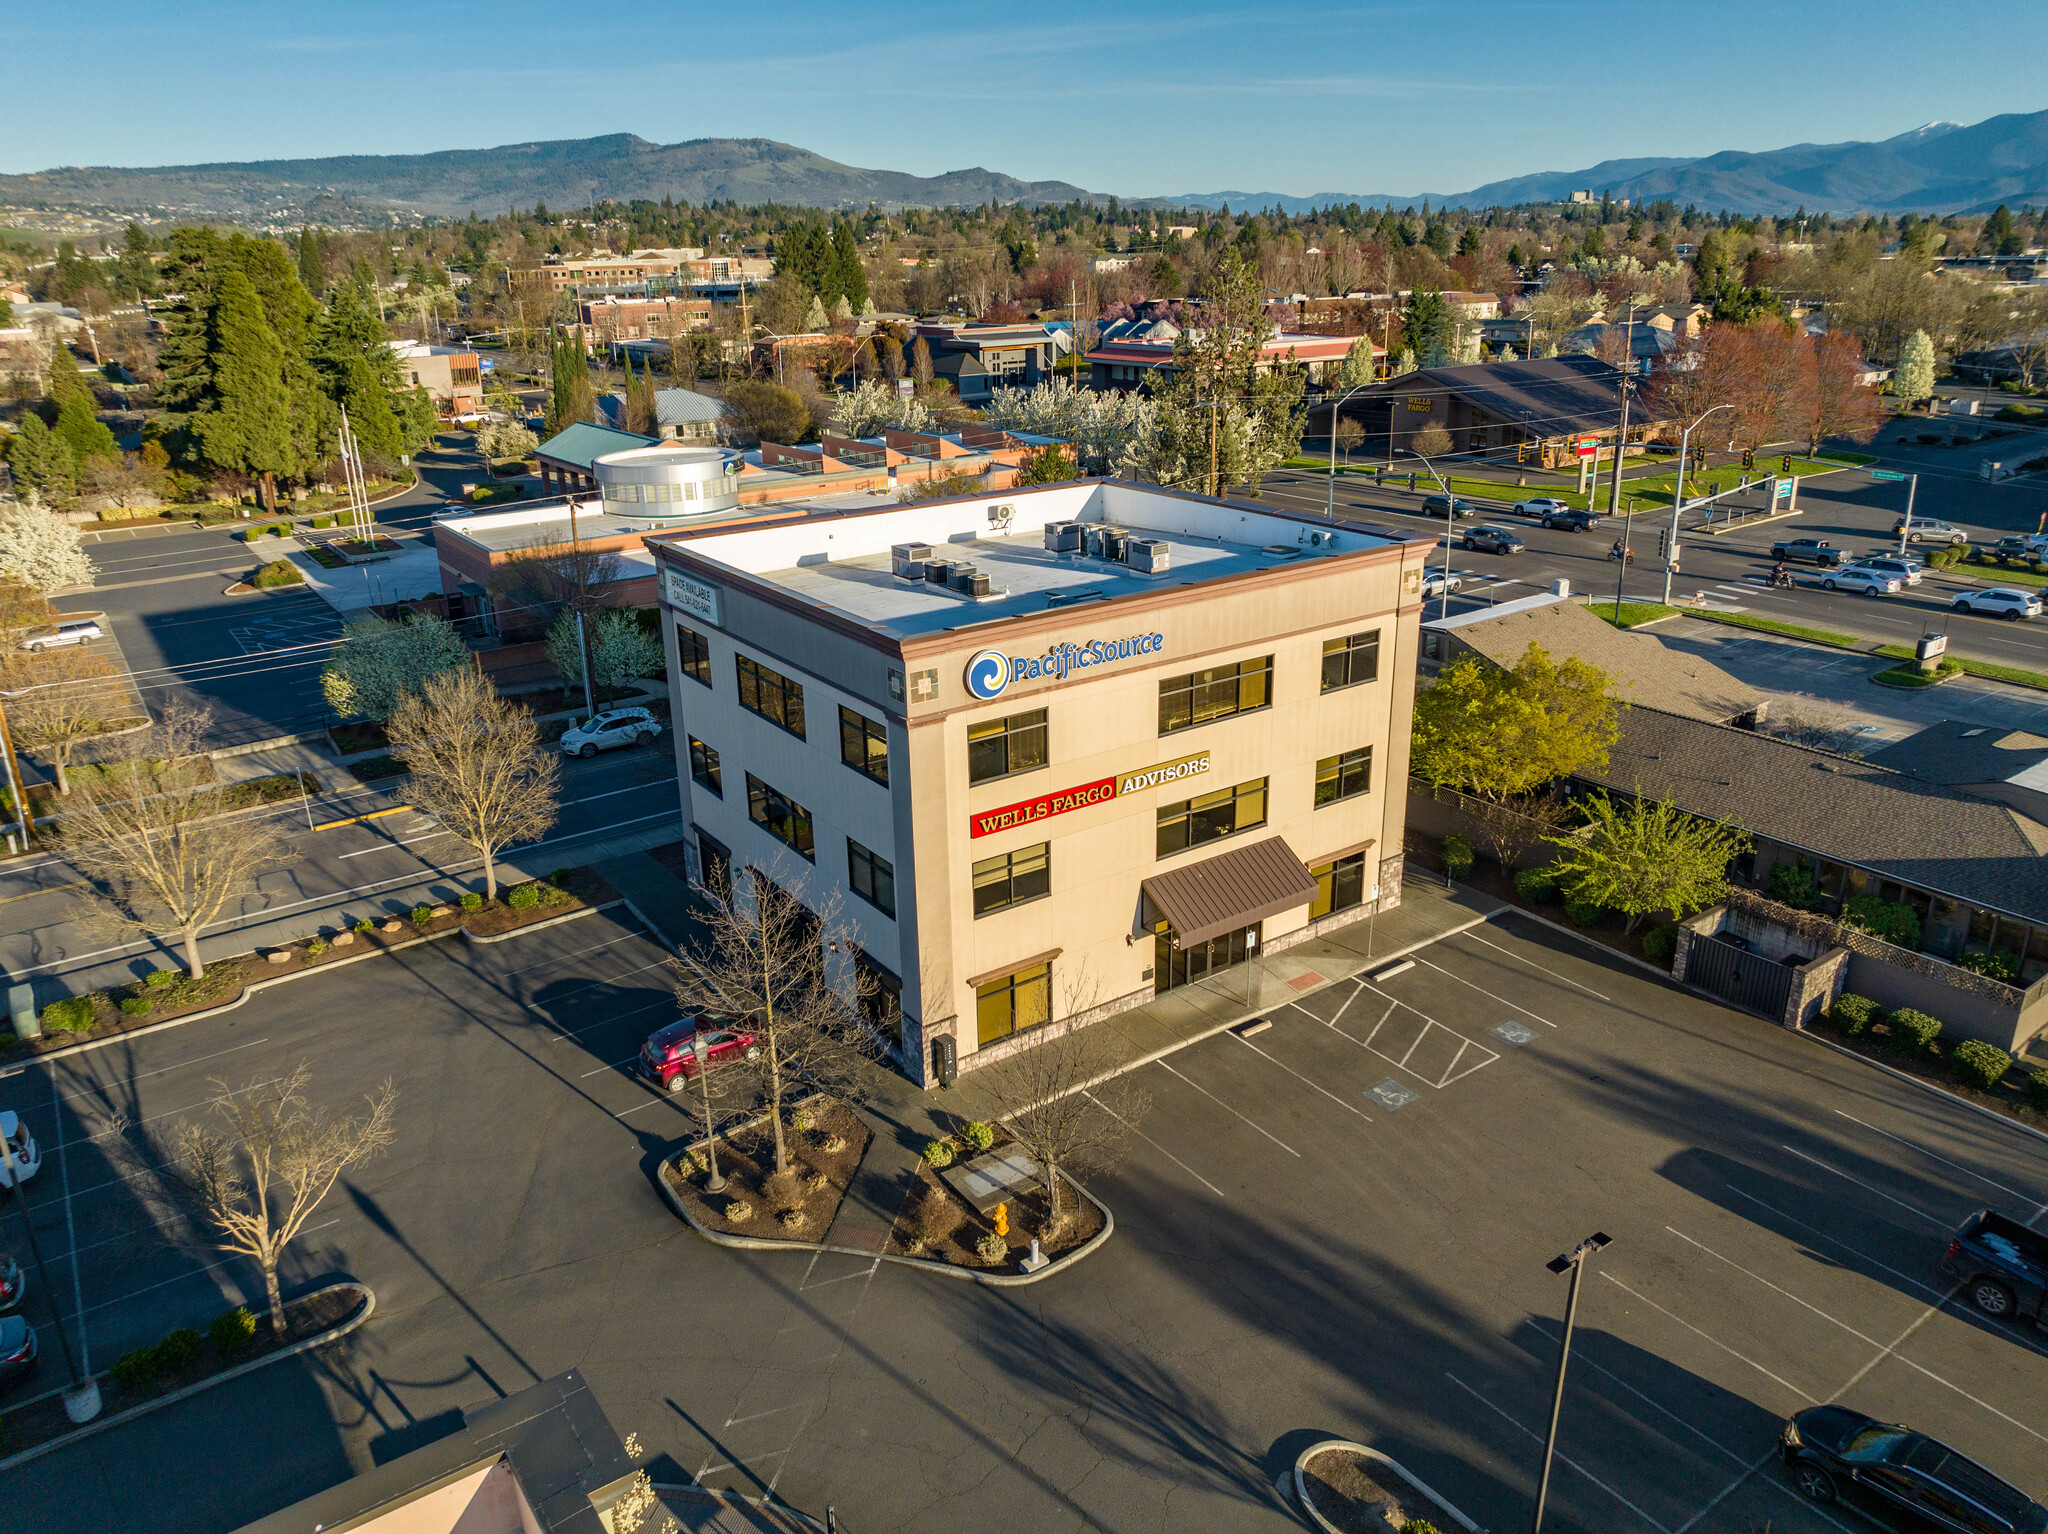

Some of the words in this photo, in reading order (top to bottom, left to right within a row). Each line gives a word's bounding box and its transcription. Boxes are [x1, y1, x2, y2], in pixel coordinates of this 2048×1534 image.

[1407, 397, 1431, 406] WELLS
[1407, 404, 1431, 412] FARGO
[670, 575, 686, 591] SPACE
[686, 582, 711, 602] AVAILABLE
[673, 590, 685, 603] CALL
[1013, 632, 1164, 683] PacificSource
[979, 802, 1048, 833] WELLS
[1051, 784, 1113, 814] FARGO
[1121, 757, 1210, 795] ADVISORS
